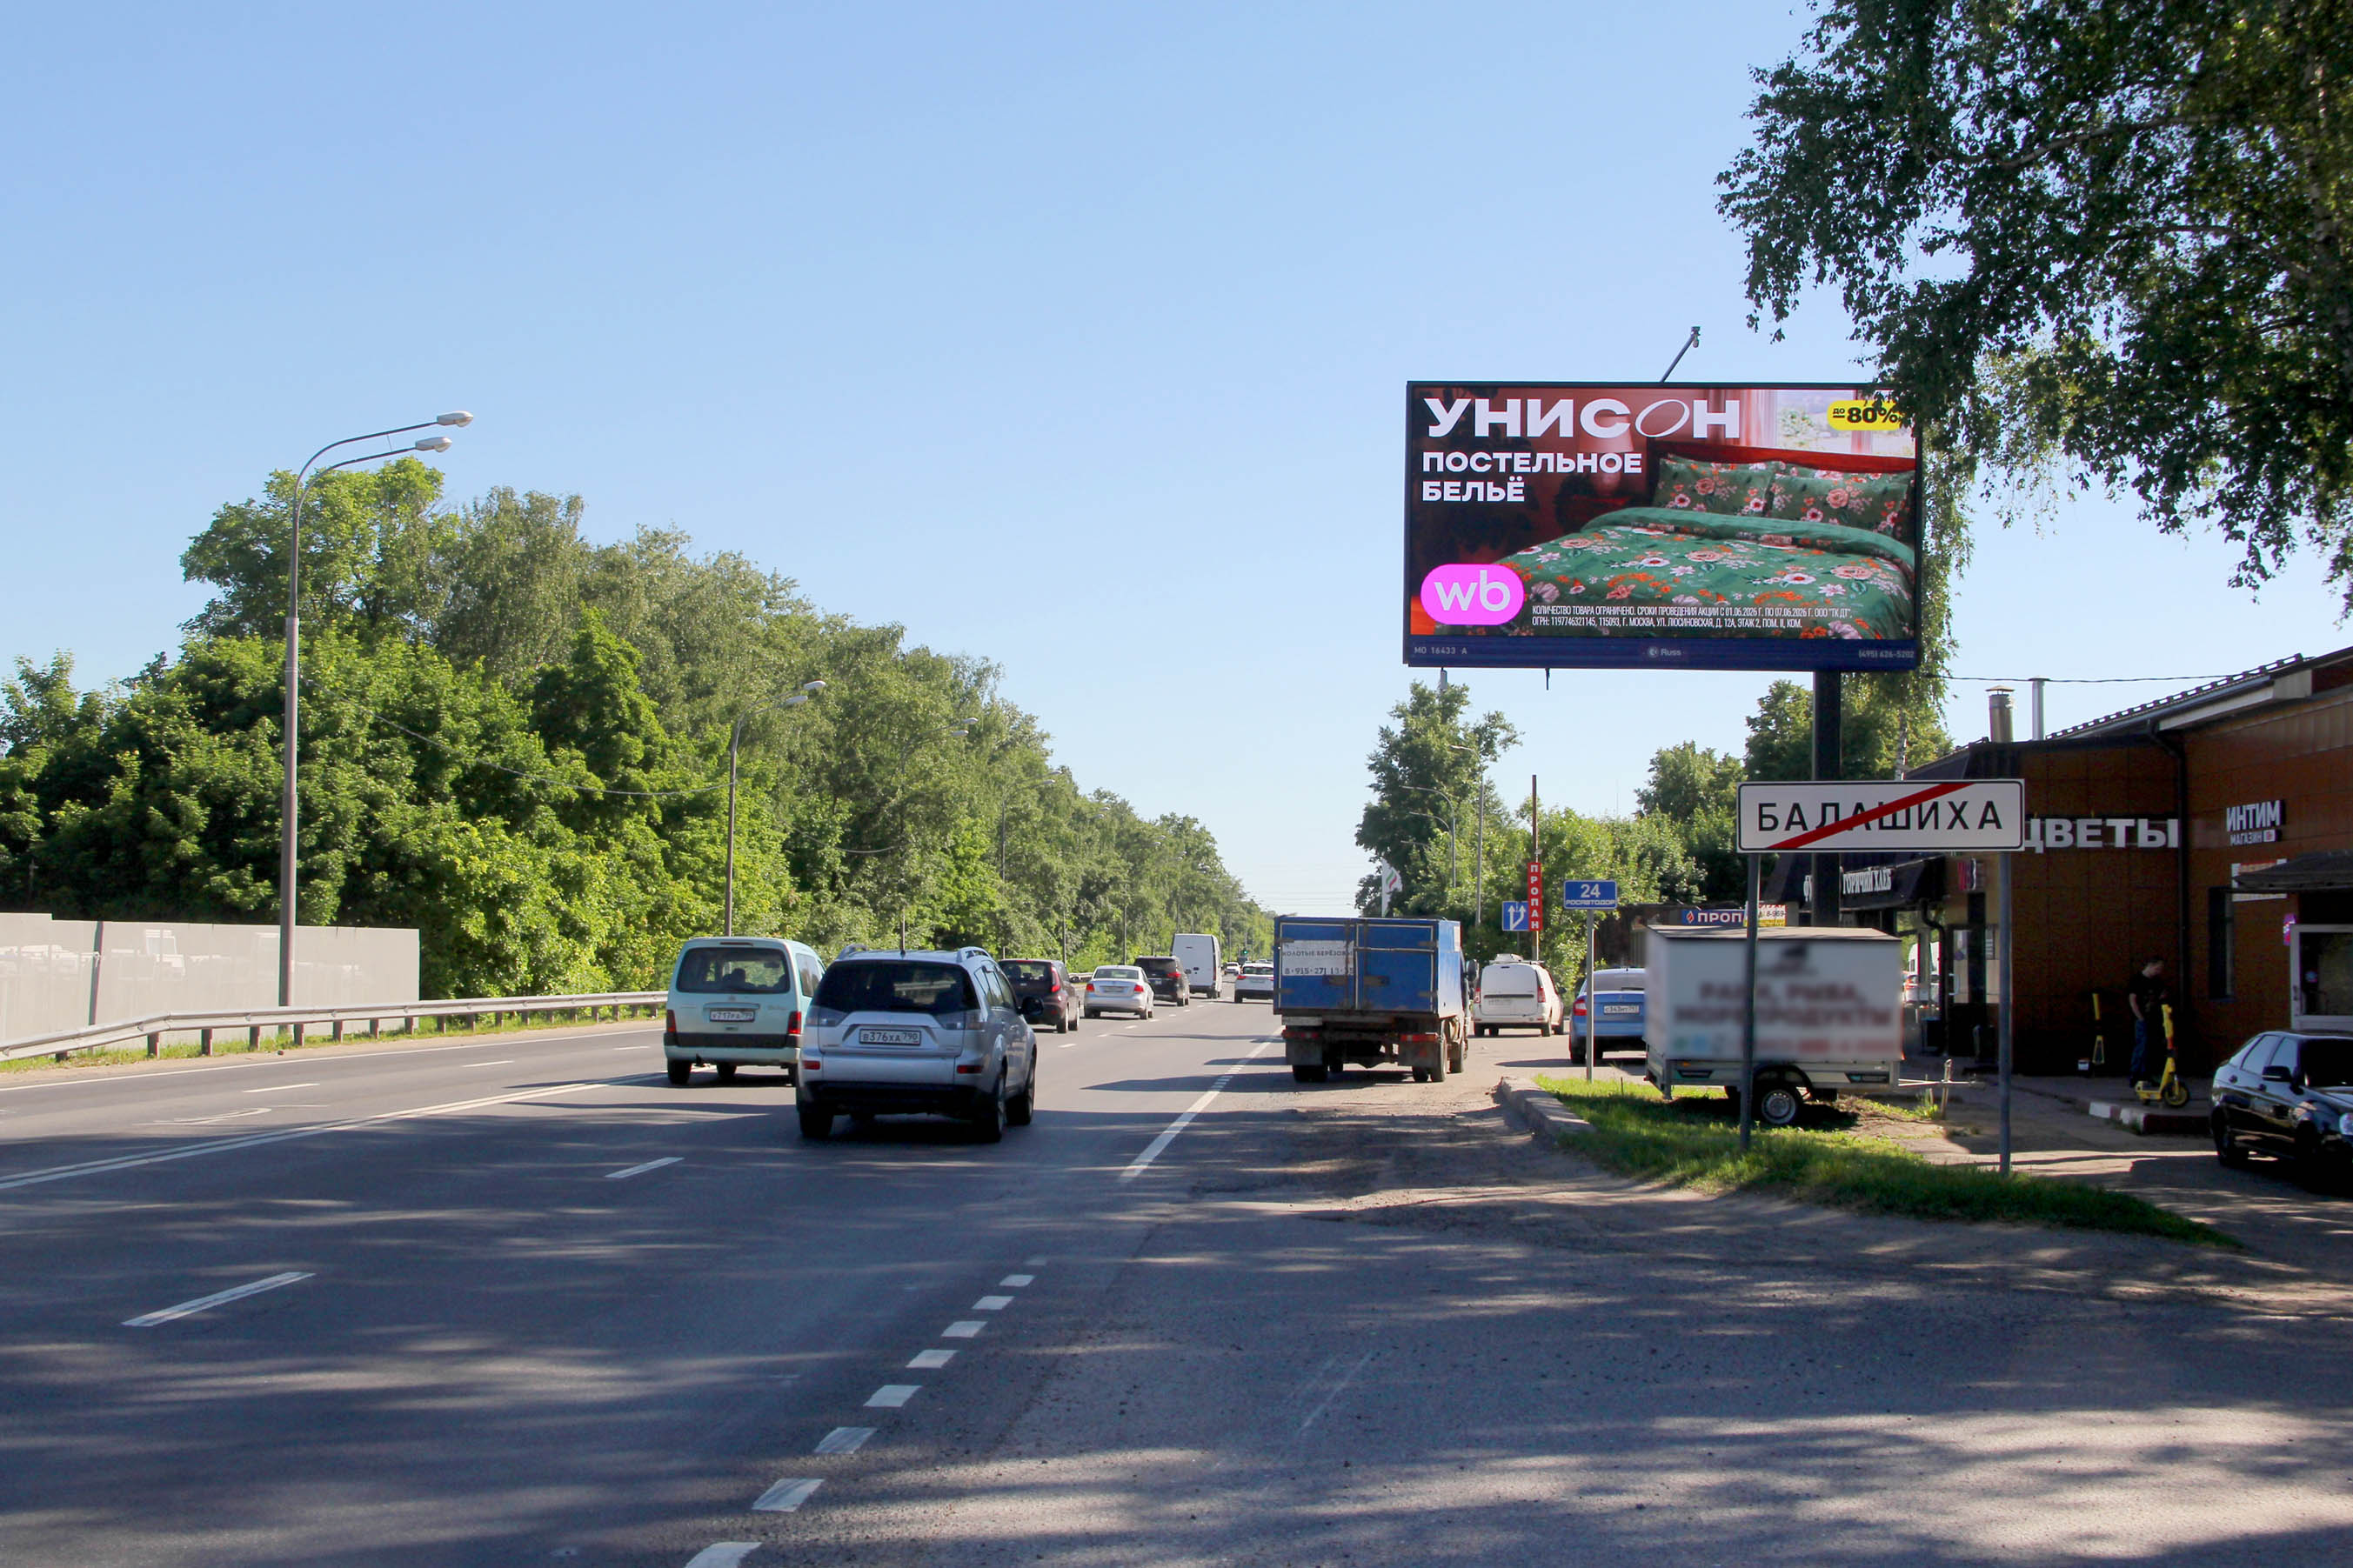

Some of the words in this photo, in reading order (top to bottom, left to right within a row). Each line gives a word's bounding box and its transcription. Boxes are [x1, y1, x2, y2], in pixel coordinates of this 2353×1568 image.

[1423, 397, 1741, 439] УНИСОН
[1422, 450, 1642, 474] ПОСТЕЛЬНОЕ
[1422, 476, 1525, 502] БЕЛЬЁ
[1434, 570, 1511, 611] wb
[1532, 605, 1572, 615] КОЛИЧЕСТВО
[1573, 605, 1594, 615] ТОВАРА
[1595, 606, 1636, 616] ОГРАНИЧЕНО.
[1637, 606, 1657, 616] СРОКИ
[1658, 606, 1697, 617] ПРОВЕДЕНИЯ
[1698, 607, 1719, 617] АКЦИИ
[1720, 607, 1724, 617] С
[1725, 607, 1757, 617] 01.06.2026
[1765, 608, 1774, 617] ПО
[1775, 608, 1807, 617] 07.06.2026
[1815, 608, 1828, 617] ООО
[1532, 617, 1549, 626] ОГРН:
[1599, 617, 1621, 628] 115093,
[1629, 617, 1655, 628] МОСКВА,
[1656, 617, 1667, 627] УЛ.
[1668, 617, 1715, 628] ЛЮСИНОВСКАЯ,
[1737, 618, 1755, 628] ЭТАЖ
[1757, 799, 2003, 831] БАЛАШИХА
[2226, 799, 2281, 832] ИНТИМ
[2024, 818, 2179, 854] ЦВЕТЫ
[2229, 830, 2263, 846] МАГАЗИН
[1580, 884, 1601, 898] 24
[1842, 871, 1873, 895] ГОРЯЧИЙ
[1874, 869, 1892, 891] ХЛЕБ
[1530, 864, 1539, 930] ПРОПАН
[1697, 912, 1742, 923] ПРОП
